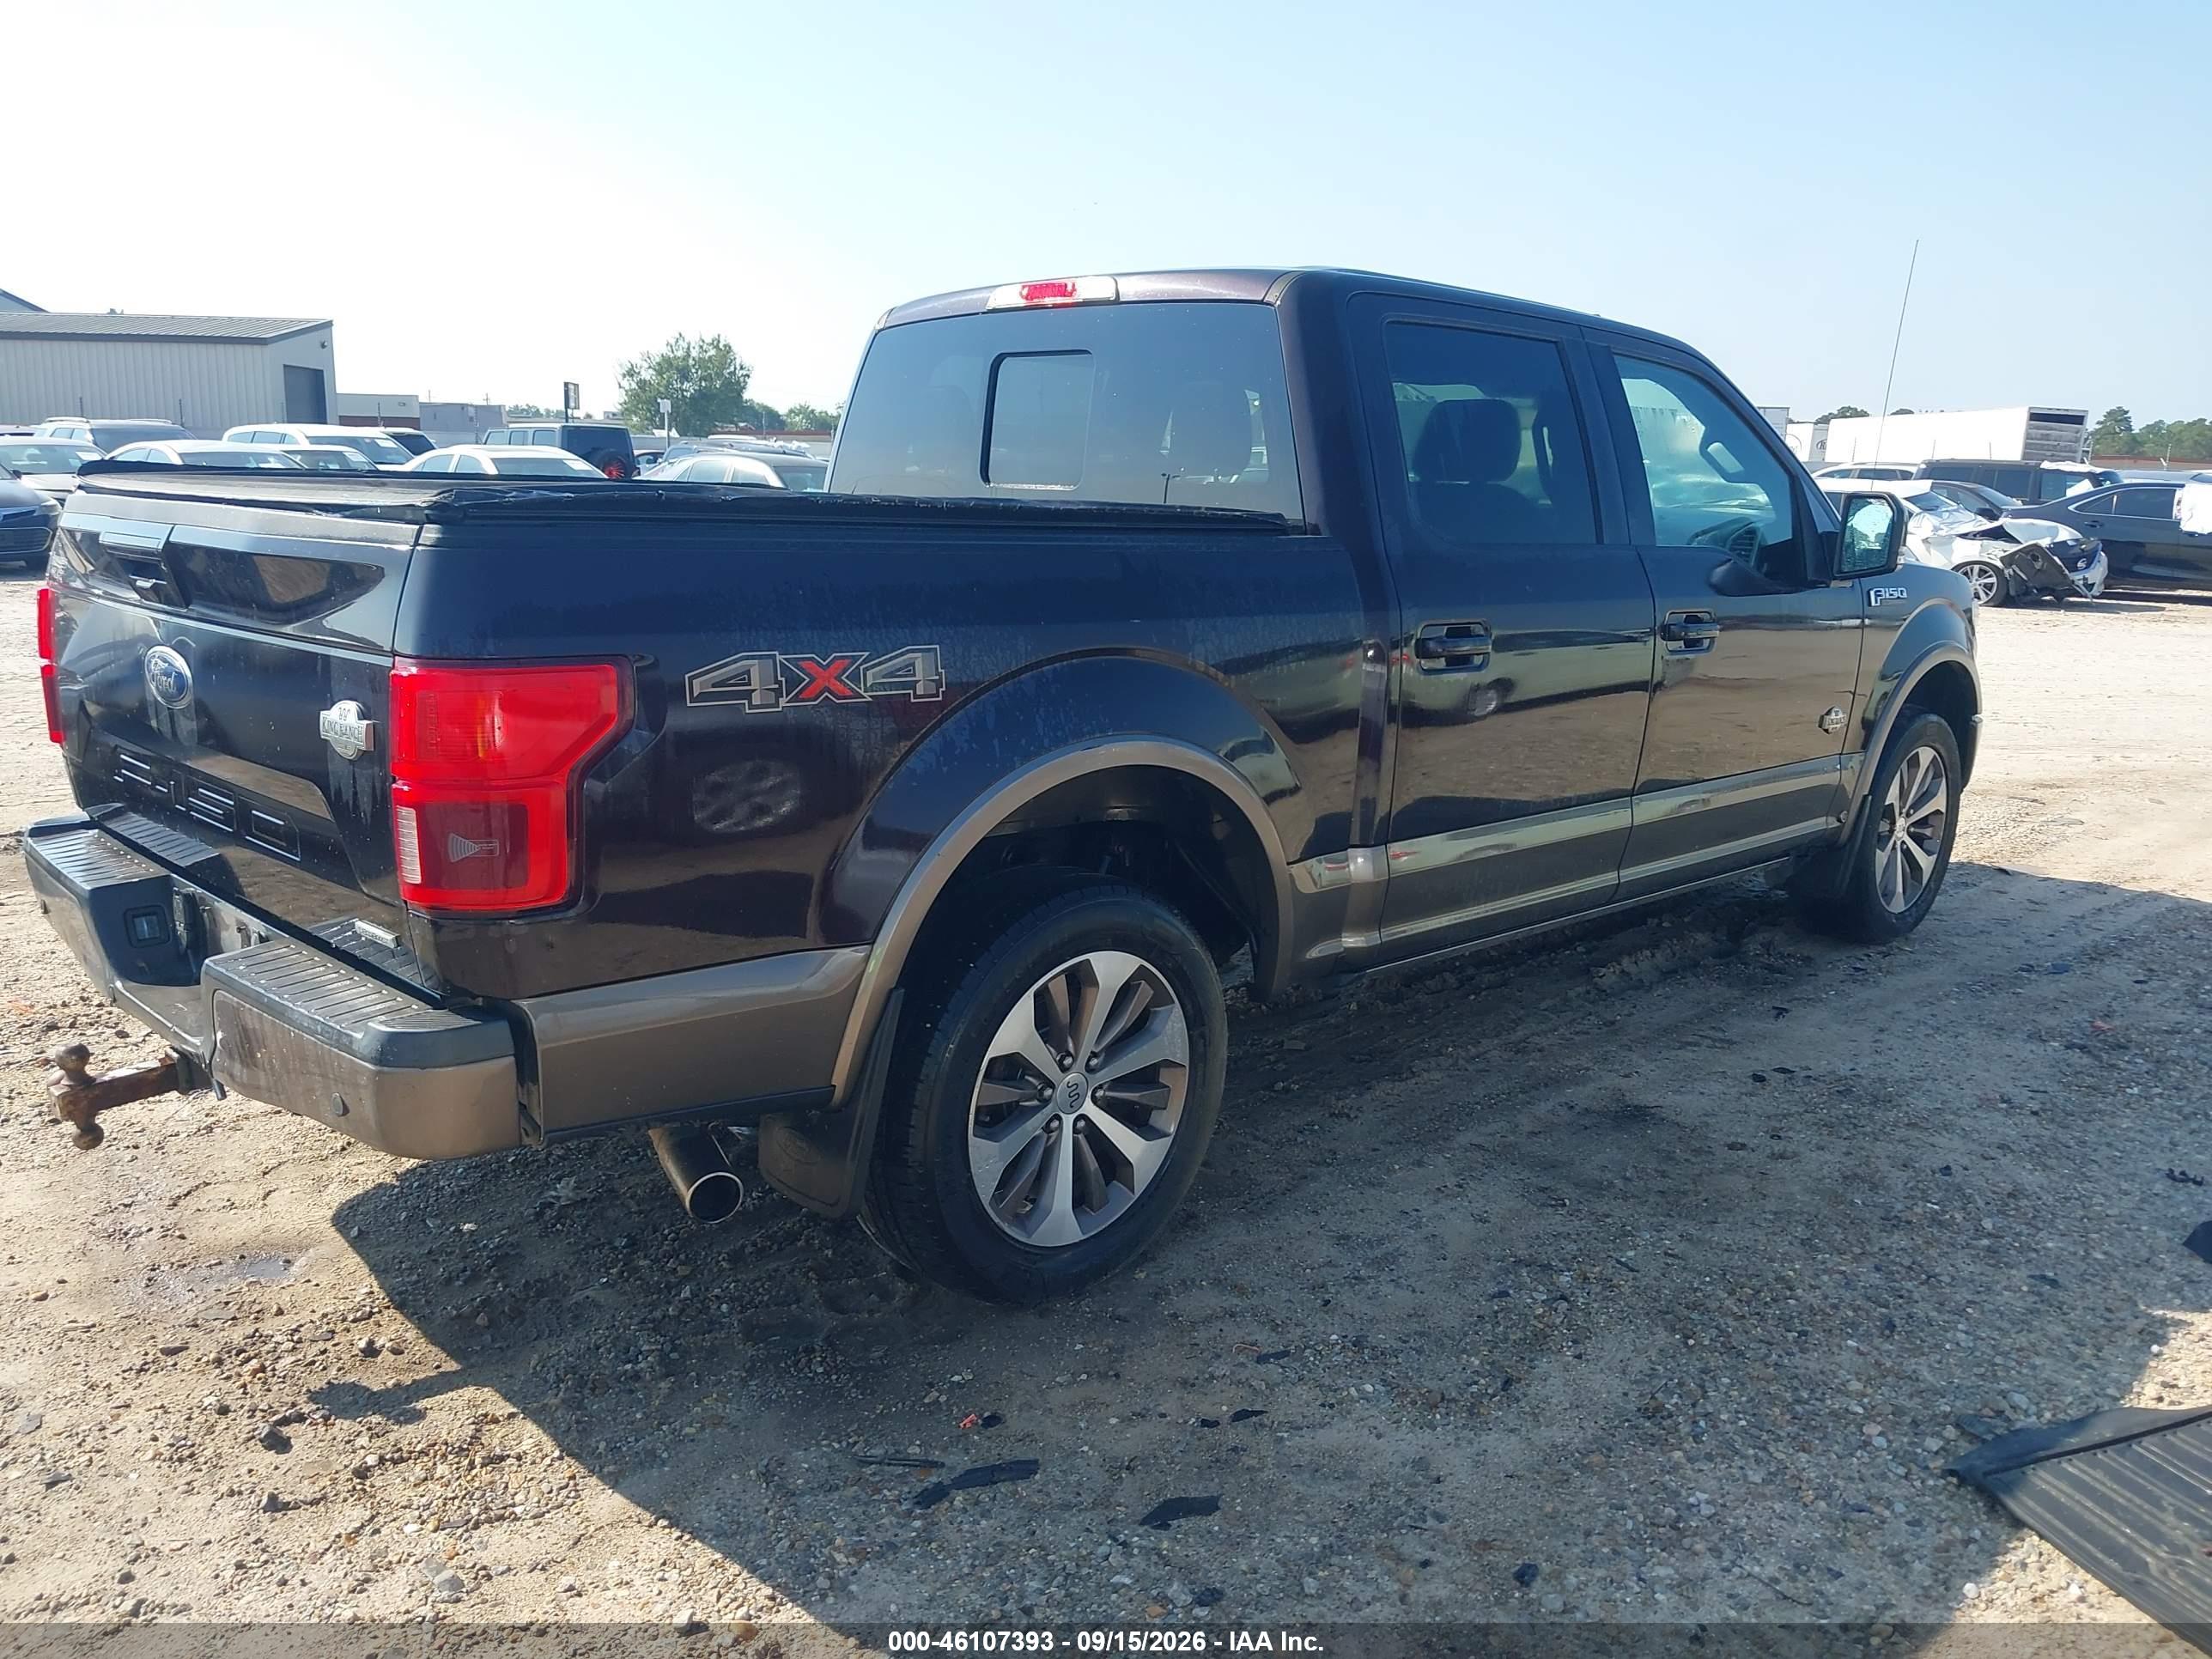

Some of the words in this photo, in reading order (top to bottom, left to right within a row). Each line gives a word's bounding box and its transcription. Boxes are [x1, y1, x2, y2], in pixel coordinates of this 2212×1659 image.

[149, 655, 177, 692] Ford
[322, 716, 339, 737] KING
[339, 722, 363, 744] RANCH
